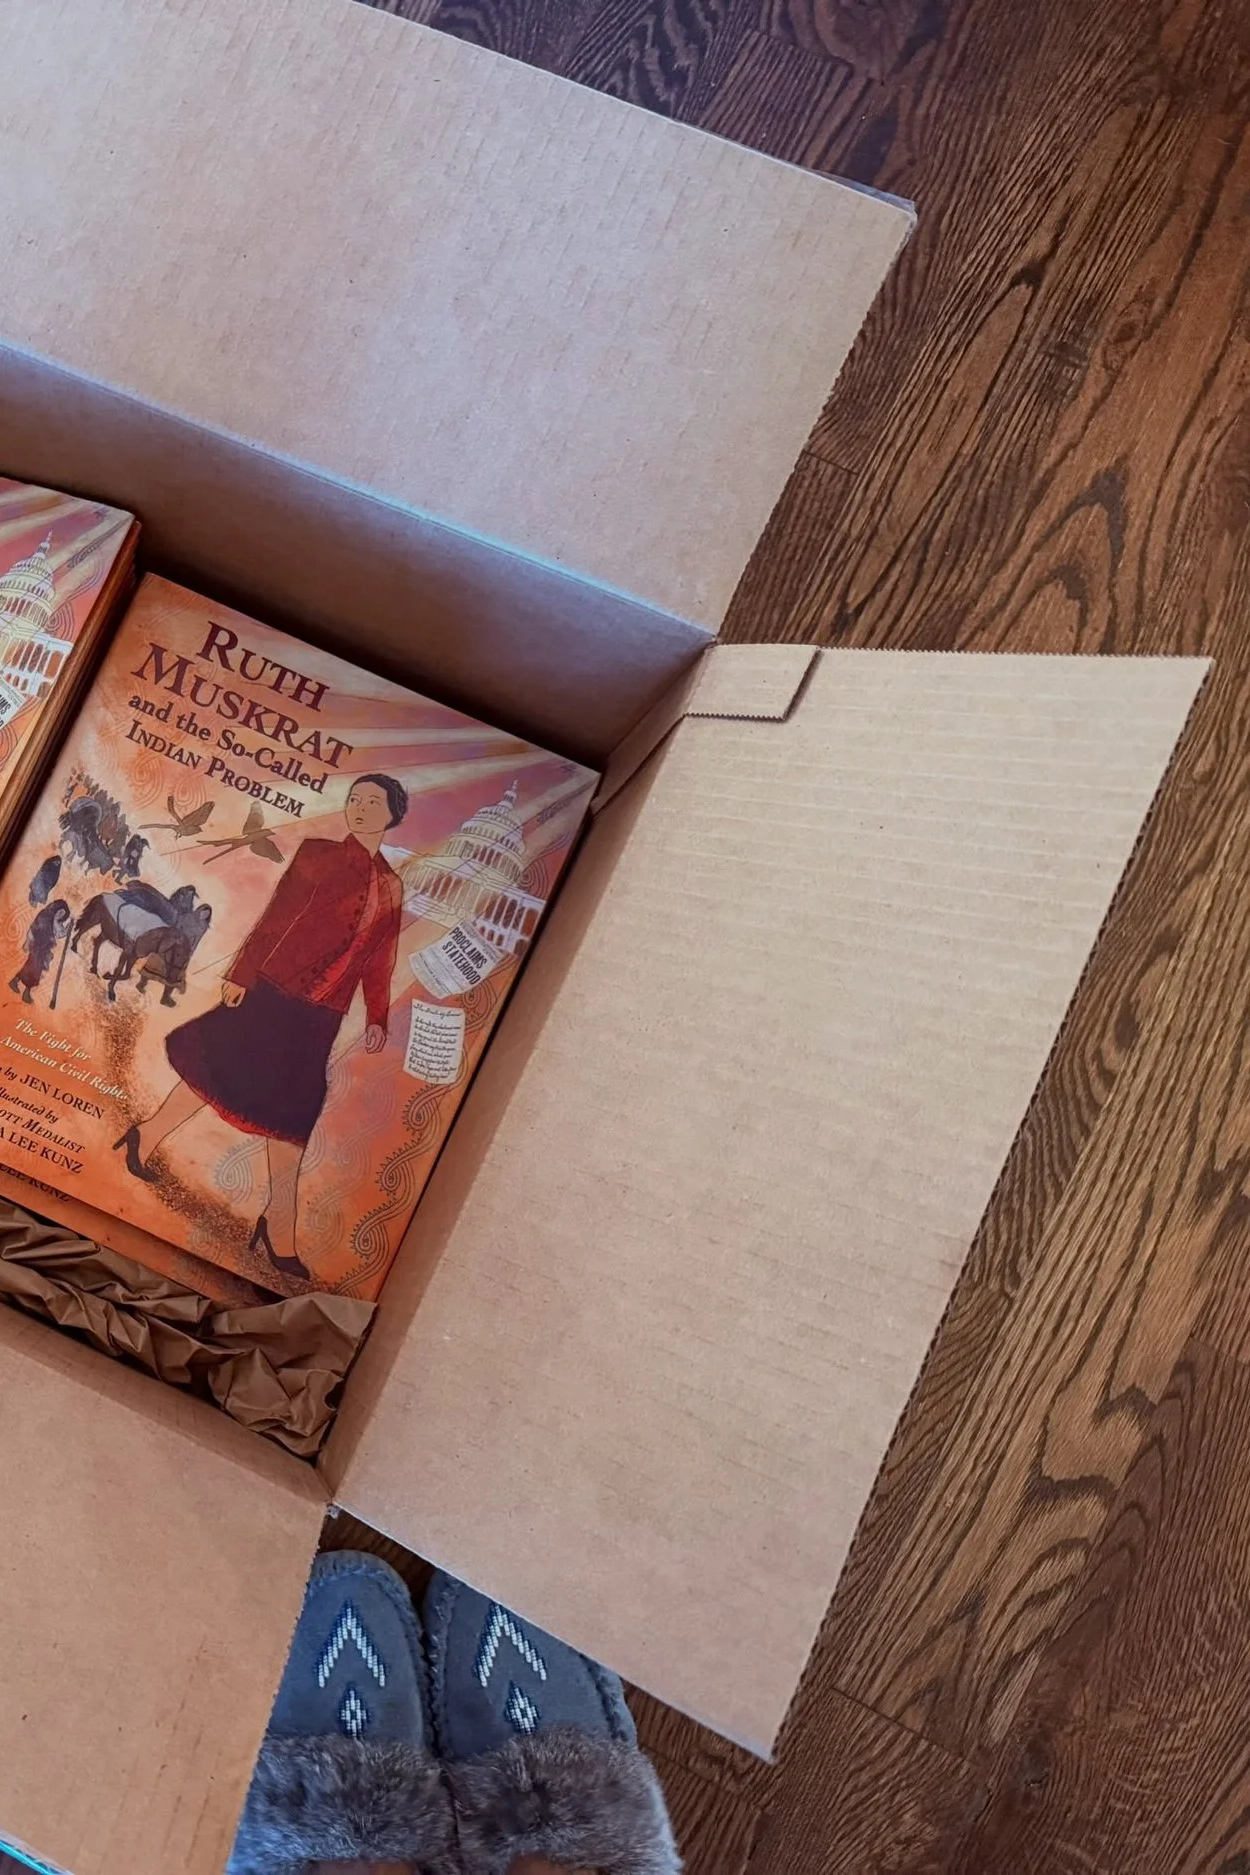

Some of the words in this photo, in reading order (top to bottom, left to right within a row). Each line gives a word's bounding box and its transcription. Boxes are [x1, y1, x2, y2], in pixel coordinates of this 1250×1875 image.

[197, 621, 330, 712] RUTH
[131, 643, 354, 768] MUSKRAT
[129, 694, 174, 723] and
[177, 710, 211, 741] the
[217, 729, 329, 794] So-Called
[126, 720, 202, 769] INDIAN
[205, 756, 305, 818] PROBLEM
[443, 942, 481, 985] STATEHOOD
[450, 927, 487, 969] PROCLAIMS
[15, 1018, 37, 1037] The
[39, 1031, 71, 1053] Fight
[73, 1046, 91, 1062] for
[1, 1036, 57, 1068] American
[59, 1063, 88, 1083] Civil
[90, 1075, 128, 1100] Rights
[4, 1067, 18, 1081] by
[20, 1074, 51, 1095] JEN
[52, 1087, 105, 1120] LOREN
[45, 1107, 59, 1124] by
[8, 1131, 39, 1154] LEE
[40, 1145, 84, 1175] KUNZ
[22, 1119, 86, 1154] MEDALIST
